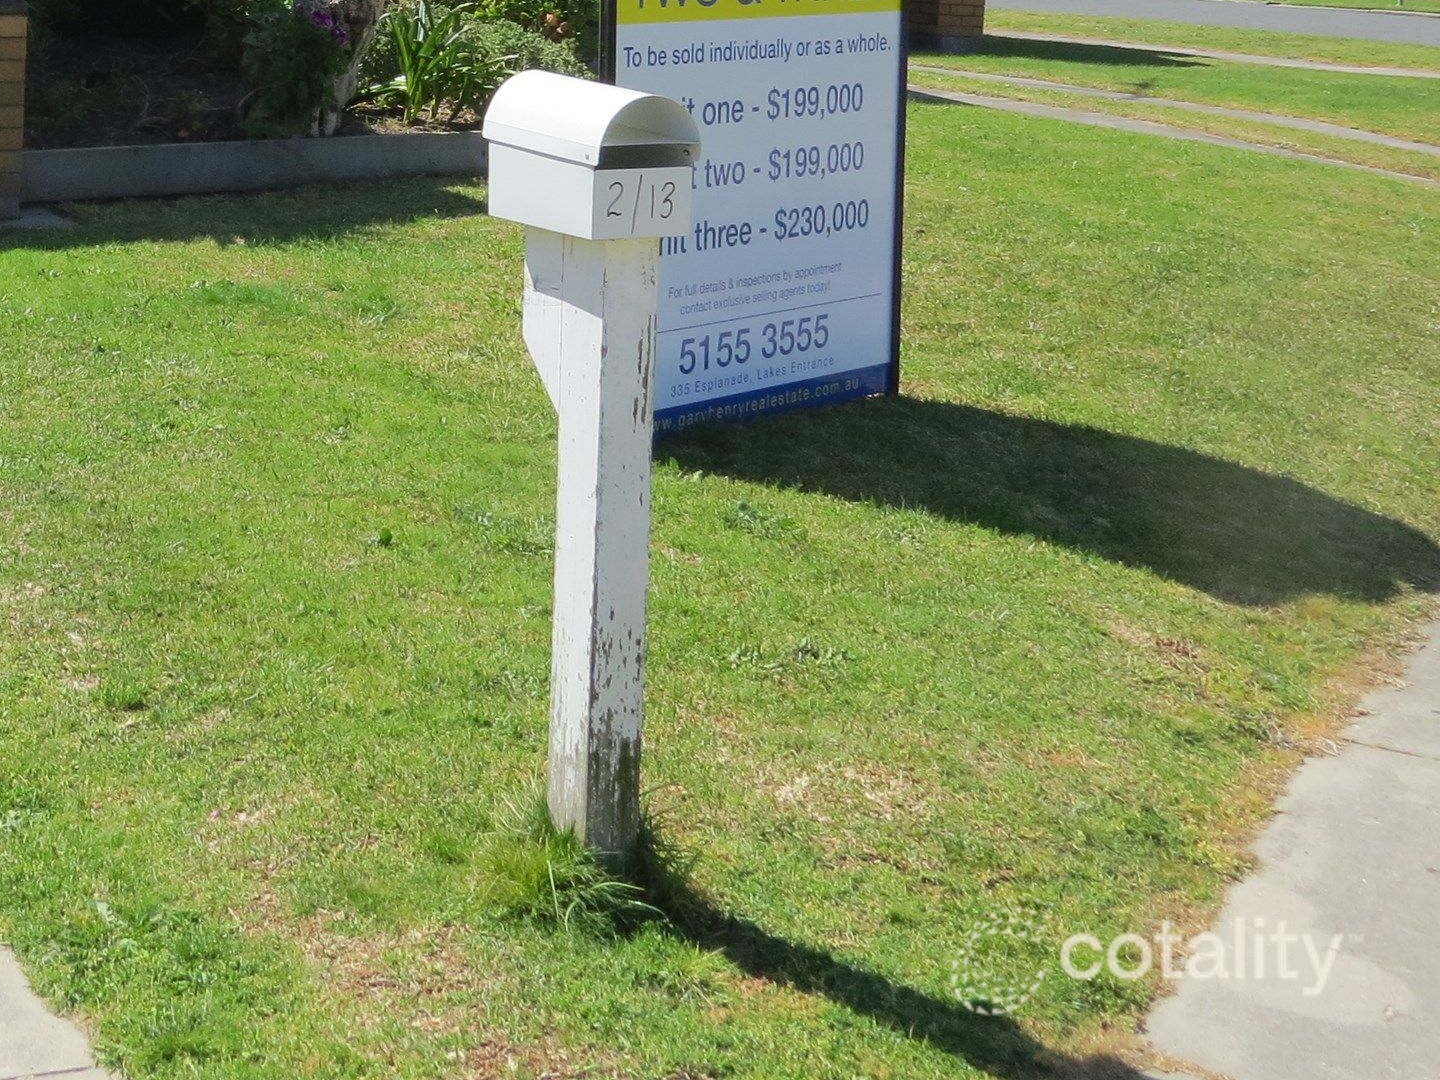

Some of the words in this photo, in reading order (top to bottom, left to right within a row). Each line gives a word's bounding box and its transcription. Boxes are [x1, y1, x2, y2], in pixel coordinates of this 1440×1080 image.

[623, 46, 642, 68] To
[647, 45, 667, 67] be
[671, 42, 705, 65] sold
[710, 37, 791, 63] individually
[796, 41, 811, 56] or
[815, 38, 831, 55] as
[836, 38, 844, 54] a
[847, 32, 891, 53] whole.
[702, 99, 744, 126] one
[766, 82, 864, 122] $199,000
[704, 159, 746, 188] two
[768, 141, 865, 183] $199,000
[606, 173, 677, 235] 2/13
[694, 220, 753, 252] three
[774, 199, 870, 245] $230,000
[667, 287, 683, 300] For
[684, 284, 698, 297] full
[699, 279, 727, 295] details
[728, 278, 734, 291] &
[735, 271, 782, 290] inspections
[782, 269, 793, 284] by
[794, 262, 843, 281] appointment
[680, 301, 712, 316] contact
[713, 294, 752, 311] exclusive
[779, 285, 806, 301] agents
[679, 328, 751, 374] 5155
[761, 314, 829, 358] 3555
[670, 382, 690, 398] 335
[694, 372, 753, 394] Esplanade,
[756, 365, 787, 381] Lakes
[790, 356, 835, 374] Entrance
[654, 377, 860, 432] ww.garyhenryrealestate.com.au
